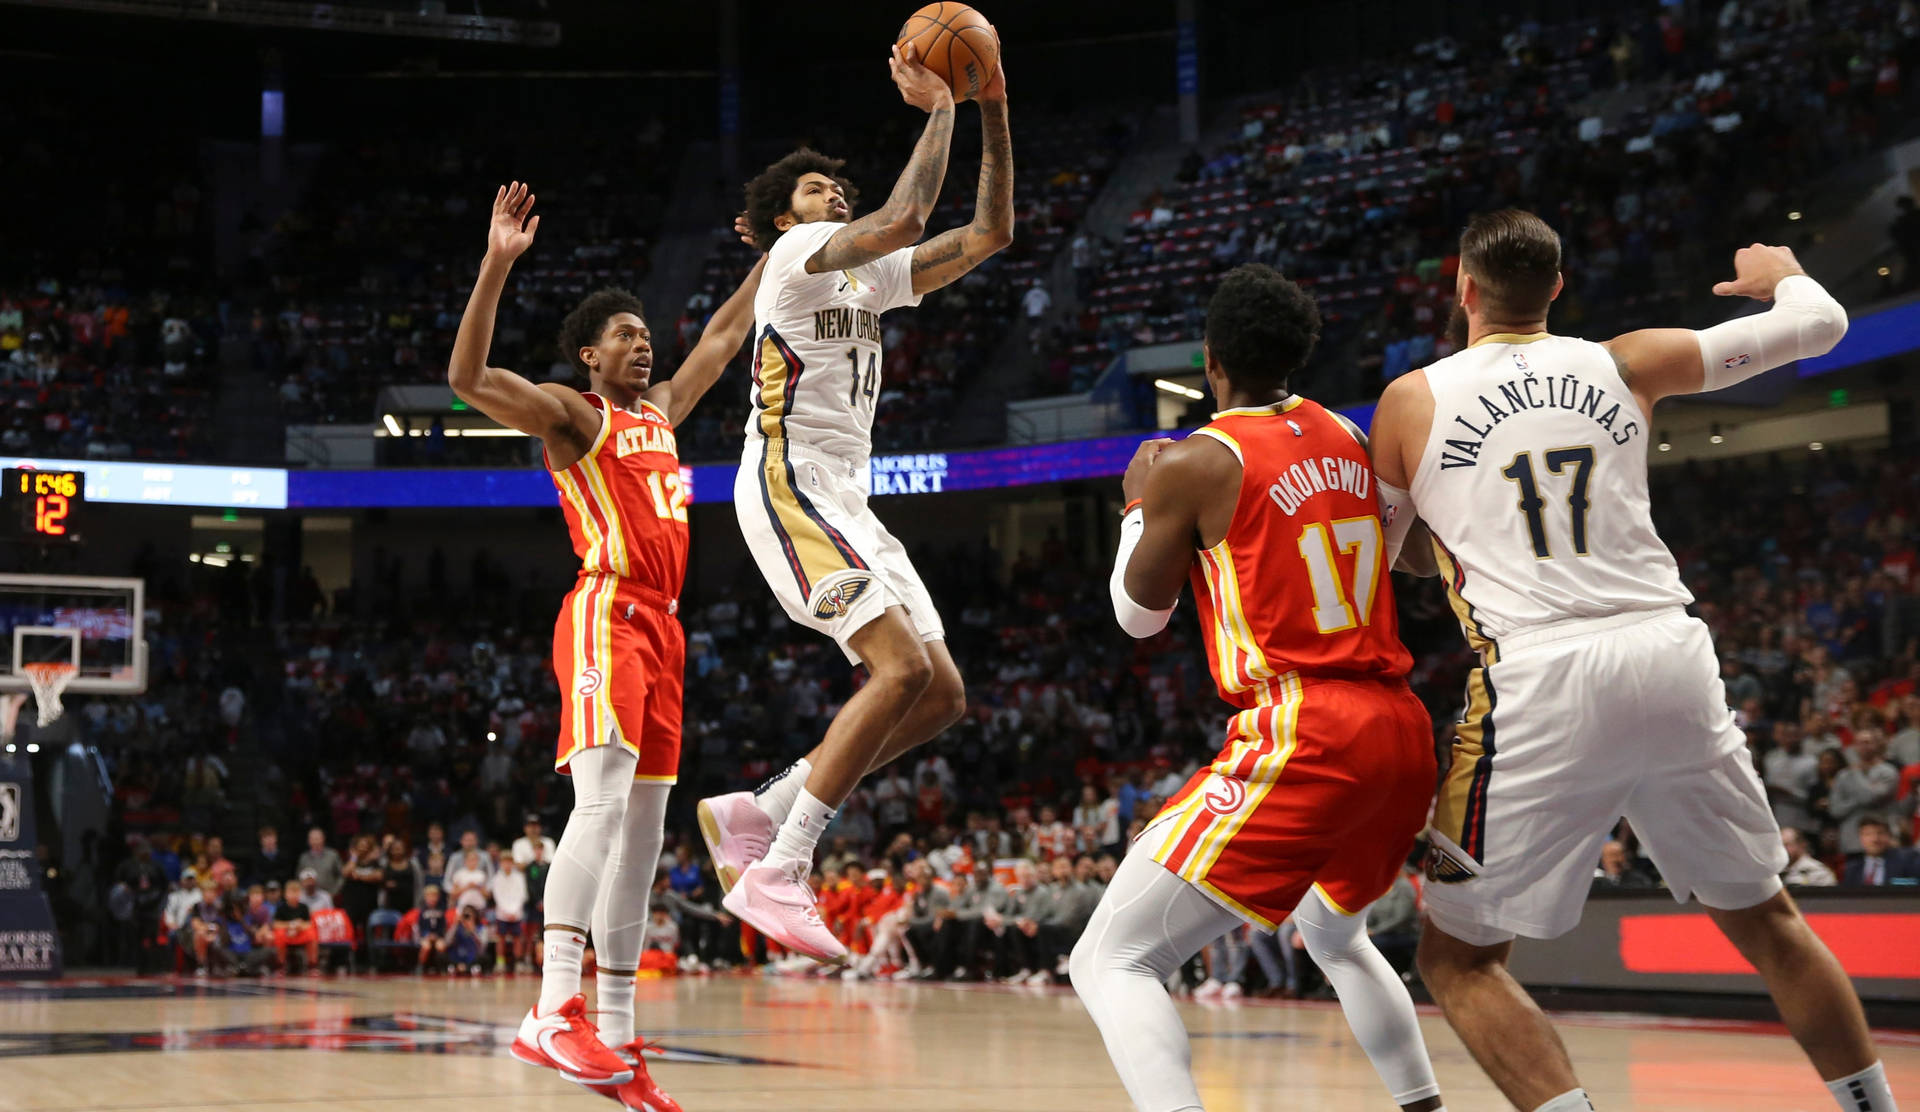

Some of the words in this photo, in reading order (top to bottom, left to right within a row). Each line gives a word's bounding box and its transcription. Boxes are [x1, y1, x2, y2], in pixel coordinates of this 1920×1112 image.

[814, 308, 853, 341] NEW
[846, 347, 877, 412] 14
[1440, 372, 1639, 470] VALANČIŪNAS
[872, 454, 948, 473] MORRIS
[872, 470, 948, 495] BART
[1268, 456, 1369, 517] OKONGWU
[36, 494, 68, 535] 12
[646, 471, 689, 523] 12
[1500, 445, 1597, 560] 17
[1297, 514, 1384, 634] 17
